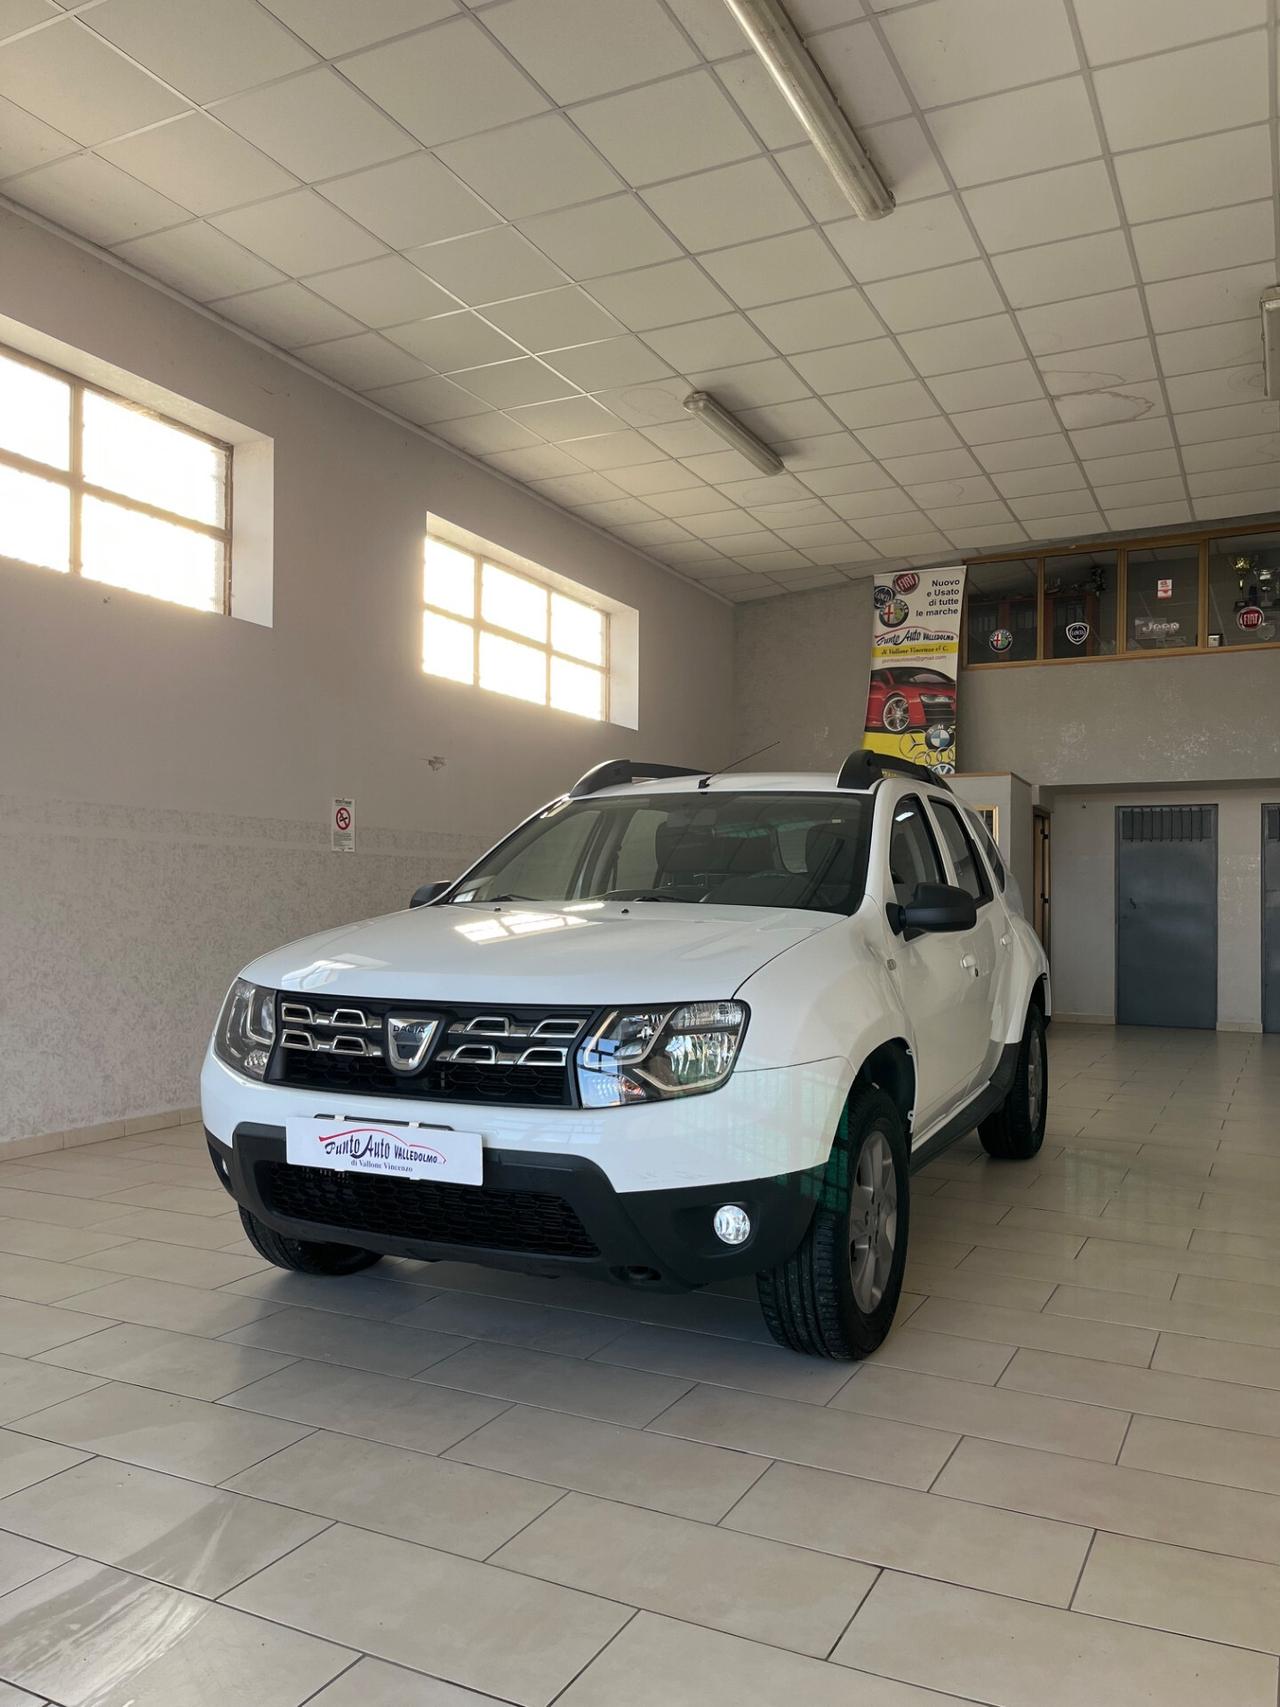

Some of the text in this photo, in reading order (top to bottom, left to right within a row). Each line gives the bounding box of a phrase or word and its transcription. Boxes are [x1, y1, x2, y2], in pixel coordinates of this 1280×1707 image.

[931, 579, 960, 587] Nuovo
[934, 588, 960, 597] Usato
[939, 598, 959, 606] tutte
[925, 607, 959, 617] marche
[1243, 613, 1259, 625] FIAT
[393, 1025, 425, 1034] DACIA
[324, 1134, 361, 1155] Punto
[394, 1145, 438, 1164] VALLEDOLMO
[359, 1159, 382, 1169] Vallone
[383, 1162, 413, 1172] Vincenzo
